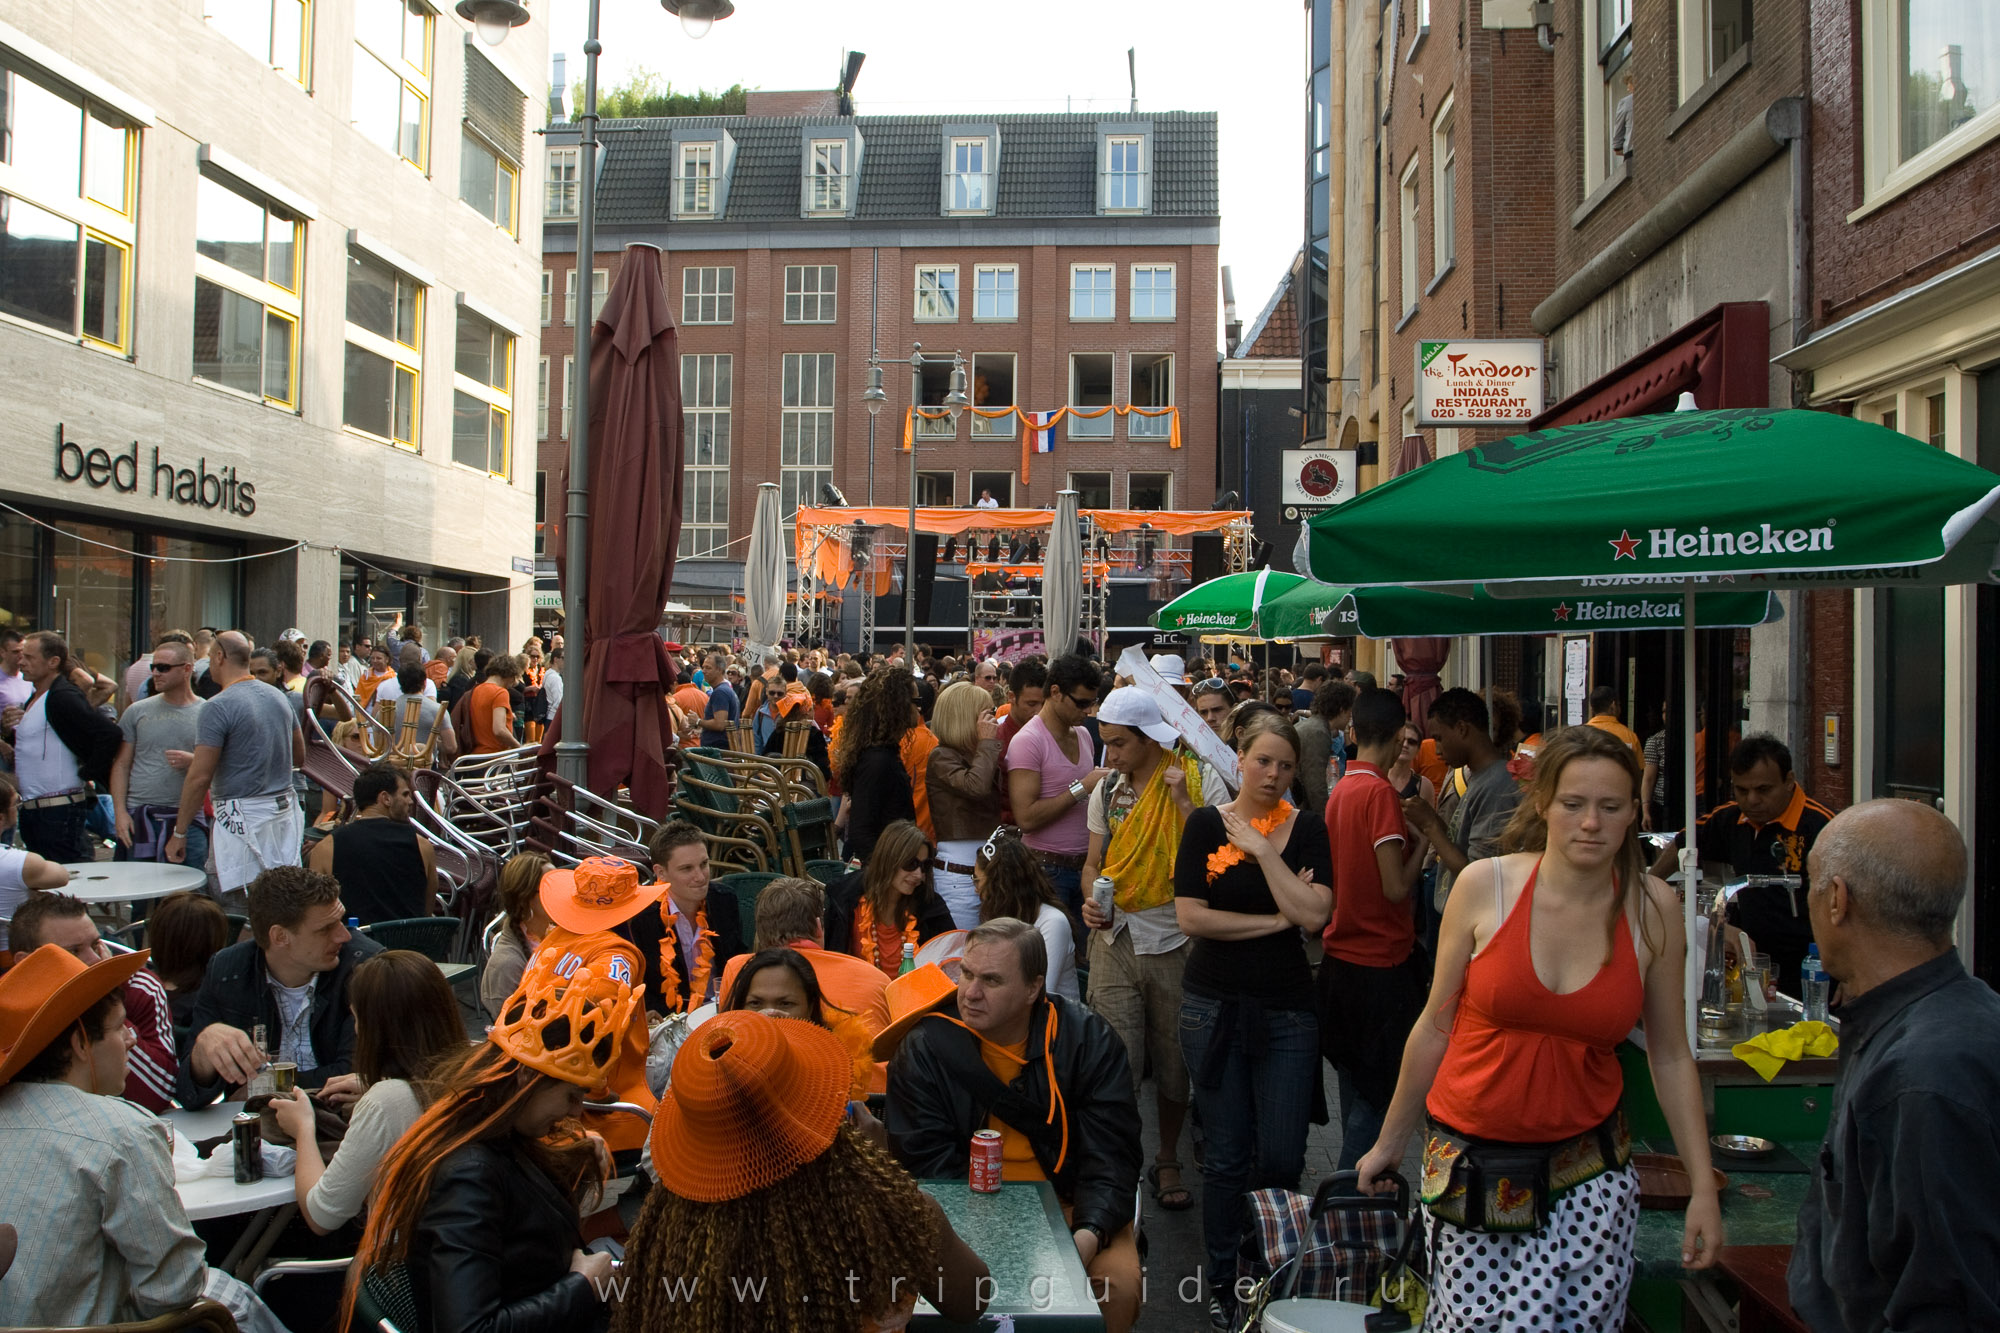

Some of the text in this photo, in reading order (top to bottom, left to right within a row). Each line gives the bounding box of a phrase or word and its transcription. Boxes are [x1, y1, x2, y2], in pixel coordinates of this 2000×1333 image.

[1422, 343, 1443, 363] HALAL
[1424, 353, 1538, 379] the Tandoor
[1446, 379, 1473, 387] Lunch
[1486, 379, 1516, 387] Dinner
[1453, 388, 1509, 397] INDIAAS
[1436, 398, 1527, 407] RESTAURANT
[1431, 409, 1455, 418] 020
[1467, 409, 1492, 418] 528
[1495, 409, 1512, 418] 92
[1515, 409, 1532, 418] 28
[1300, 453, 1338, 466] LOS AMIGOS
[55, 422, 256, 517] bed habits
[1294, 478, 1345, 502] ARGENTINIAN GRILL
[1648, 522, 1835, 558] Heineken
[1186, 612, 1238, 626] Heineken
[1575, 600, 1682, 621] Heineken
